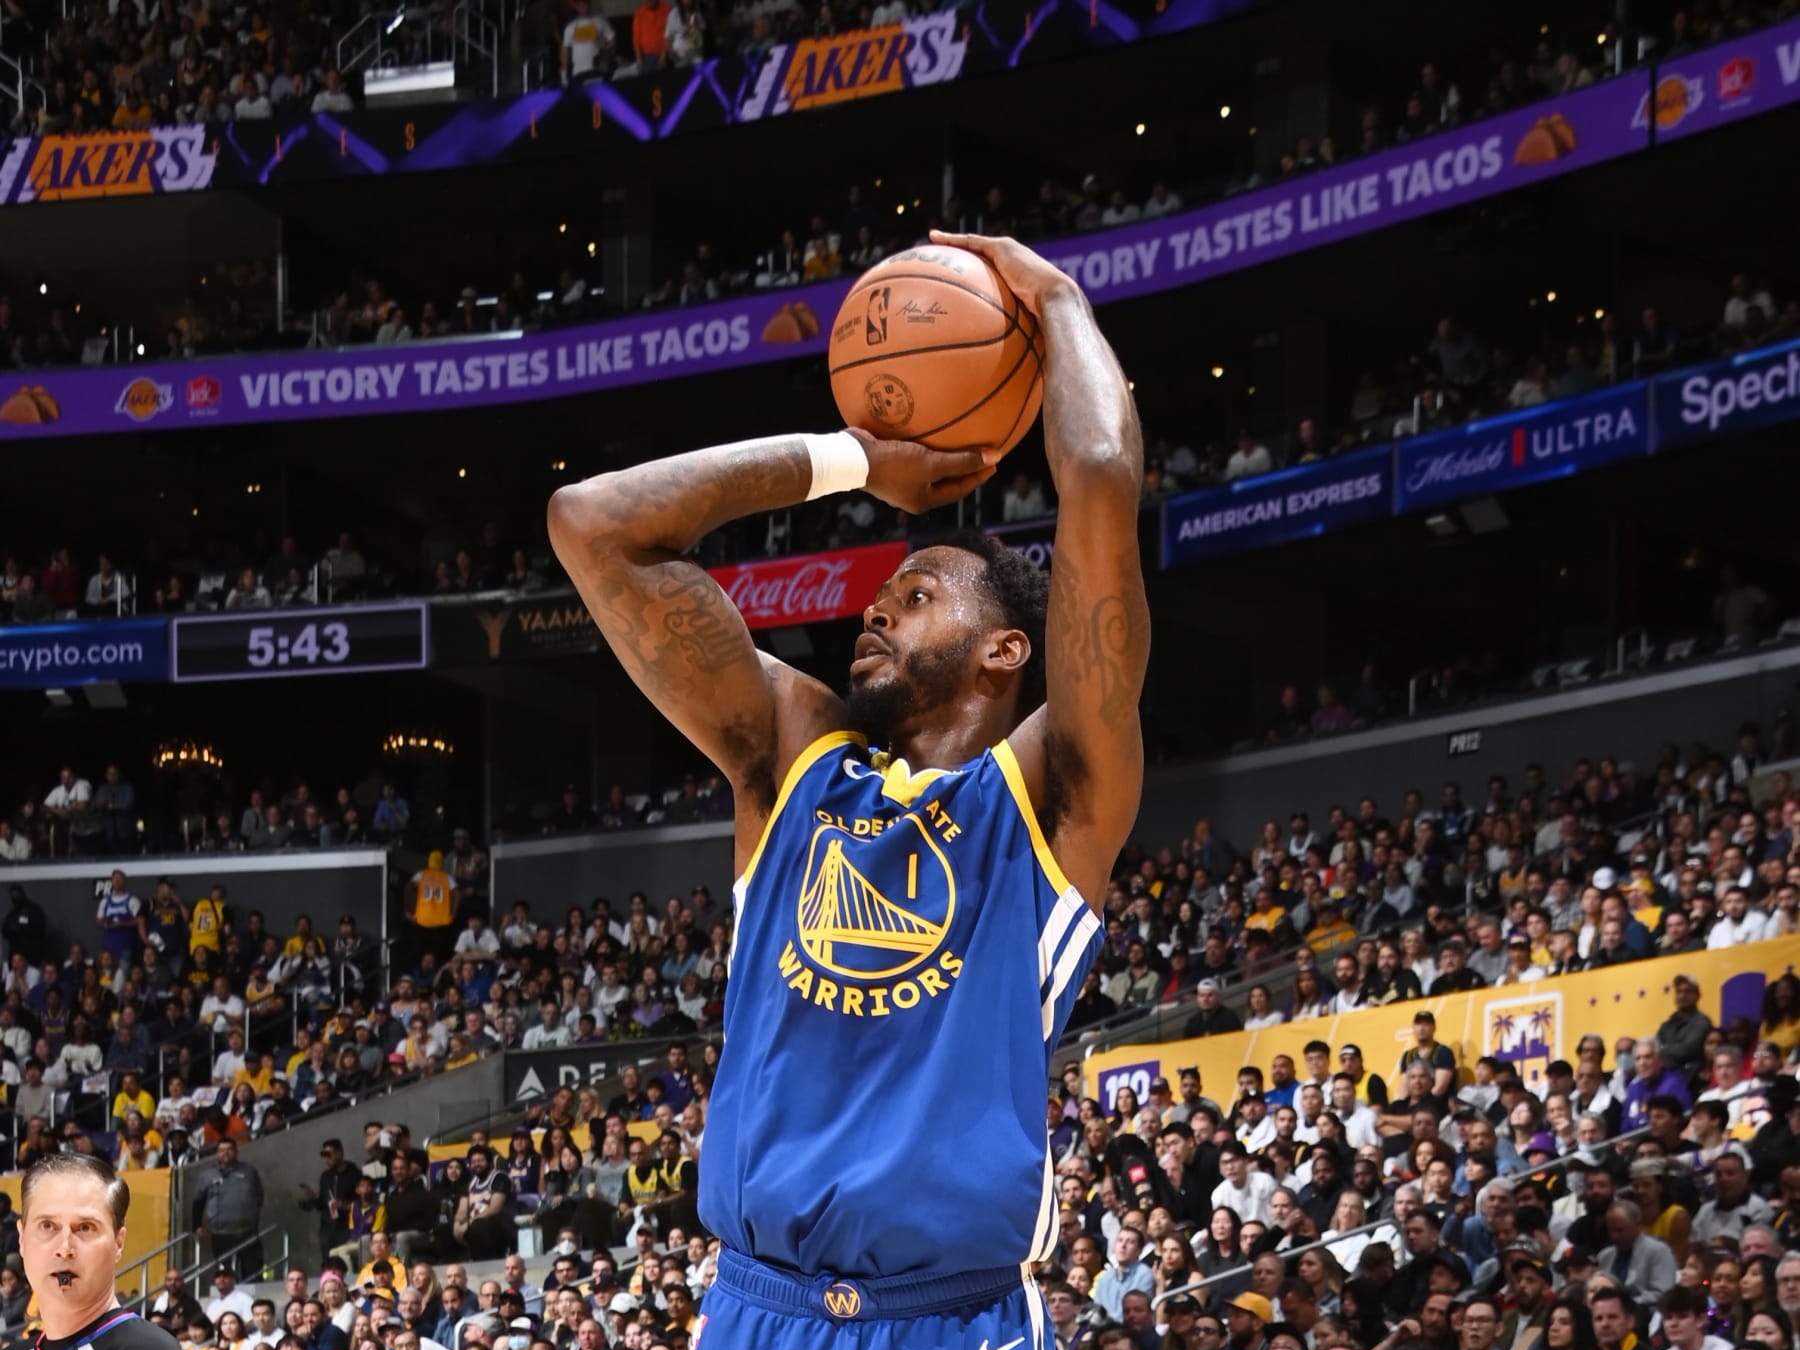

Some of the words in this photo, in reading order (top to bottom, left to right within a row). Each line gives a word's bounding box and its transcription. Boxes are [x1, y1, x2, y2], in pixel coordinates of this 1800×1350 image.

[762, 26, 954, 116] LAKERS
[4, 134, 195, 204] LAKERS
[1050, 238, 1161, 289] TORY
[1169, 201, 1293, 271] TASTES
[1301, 174, 1379, 233] LIKE
[1386, 136, 1503, 206] TACOS
[240, 362, 406, 409] VICTORY
[414, 352, 549, 395] TASTES
[556, 331, 633, 381] LIKE
[641, 315, 750, 364] TACOS
[1532, 407, 1637, 459] ULTRA
[1178, 500, 1283, 542] AMERICAN
[1287, 473, 1383, 515] EXPRESS
[247, 622, 351, 667] 5:43
[925, 799, 962, 843] ATE
[95, 880, 112, 896] PR
[778, 940, 964, 1017] WARRIORS
